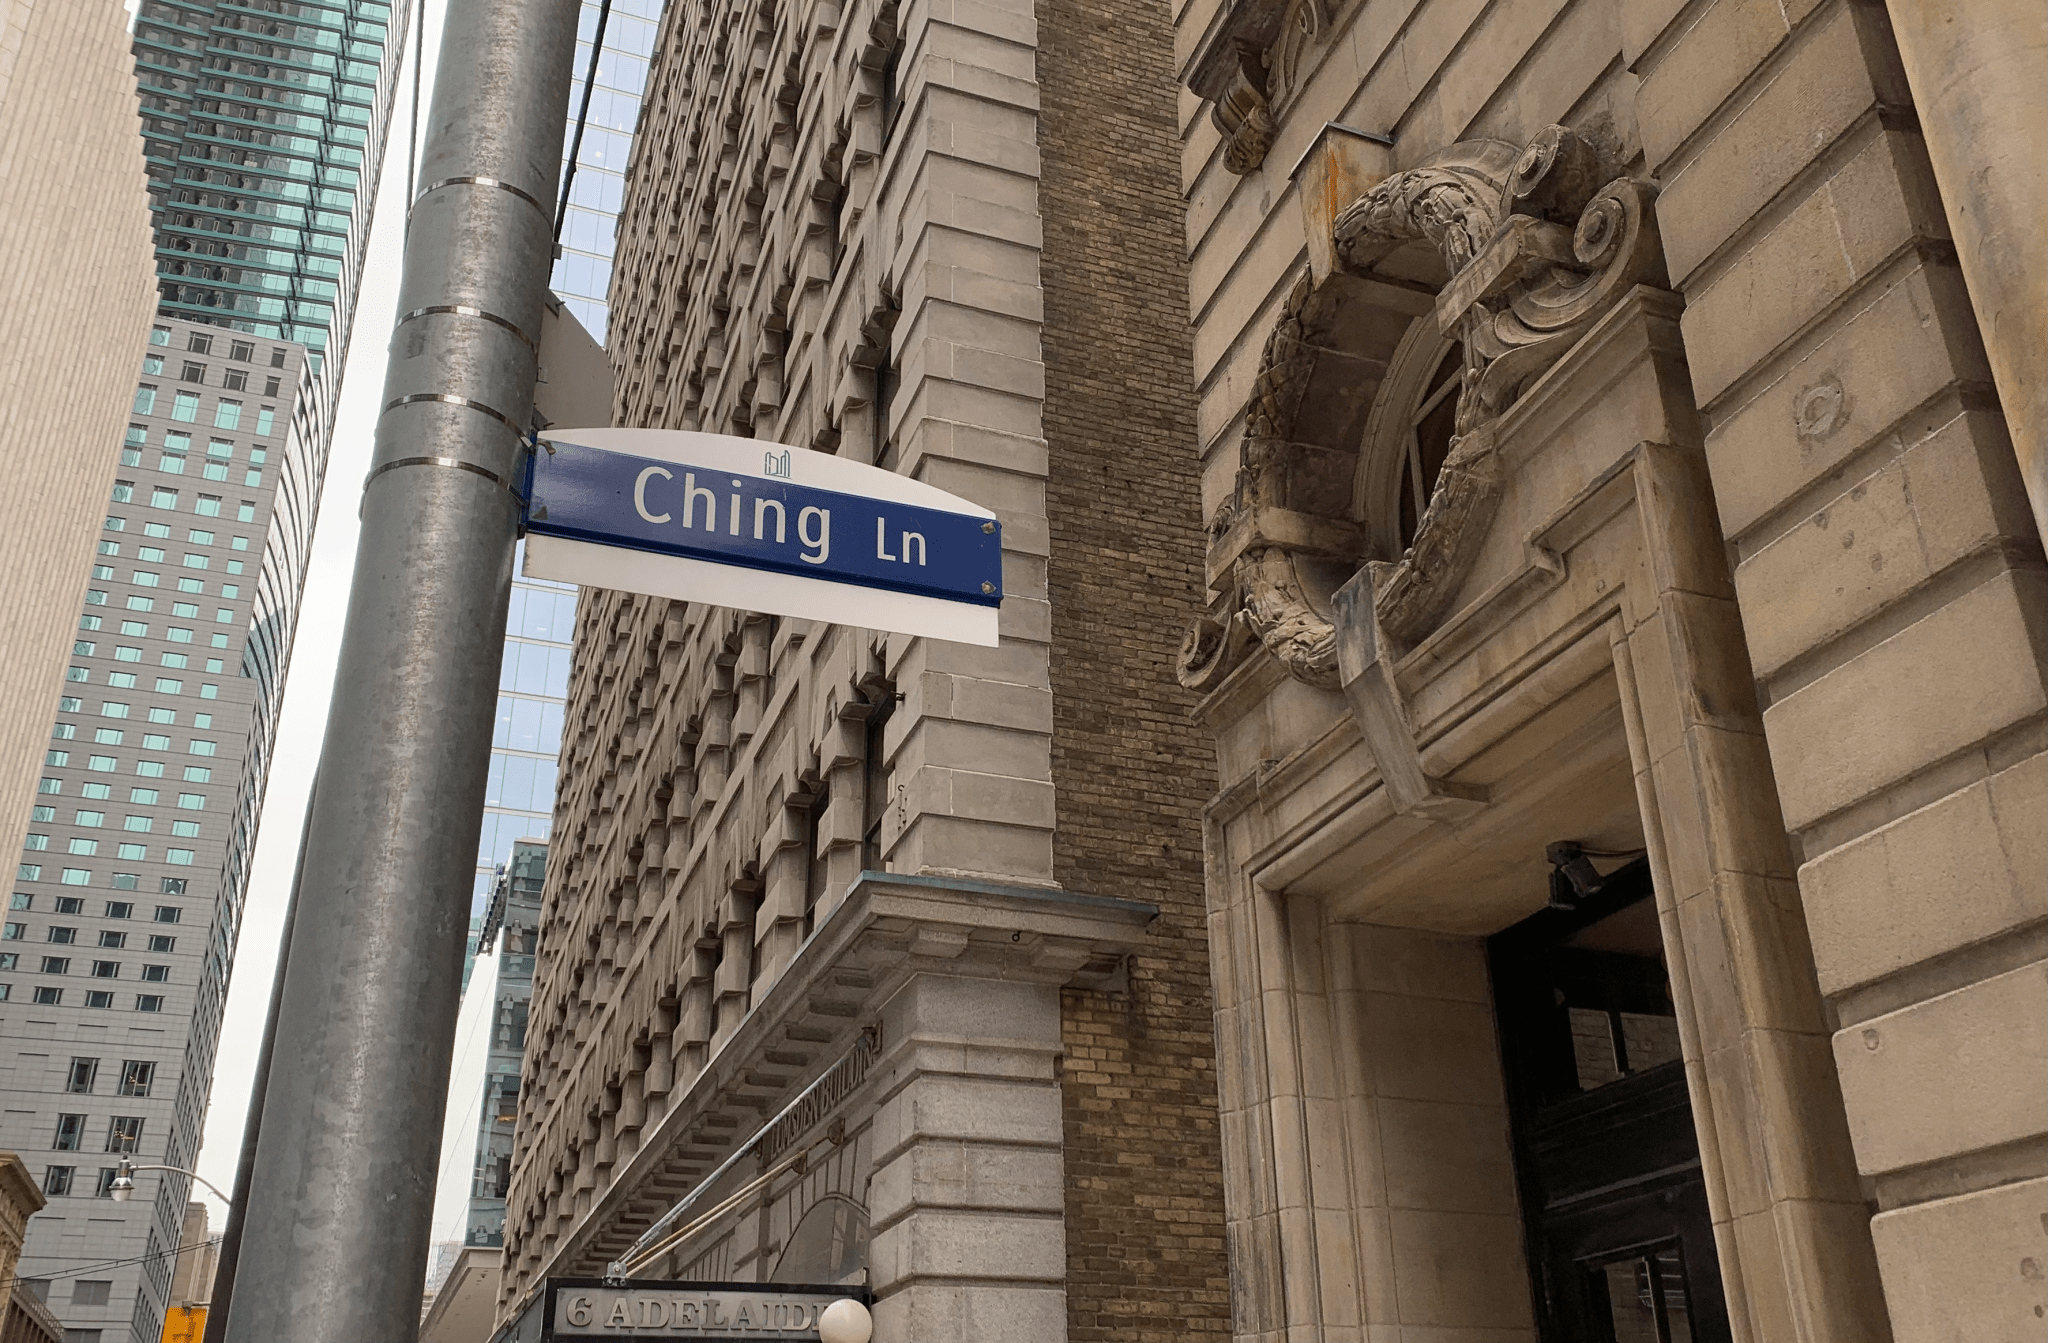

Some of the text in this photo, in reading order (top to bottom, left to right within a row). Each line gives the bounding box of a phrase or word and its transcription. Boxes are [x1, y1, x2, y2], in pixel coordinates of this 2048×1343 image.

[633, 466, 927, 567] Ching Ln
[771, 1040, 875, 1160] LUMSDEN BUILDIN
[566, 1296, 593, 1327] 6
